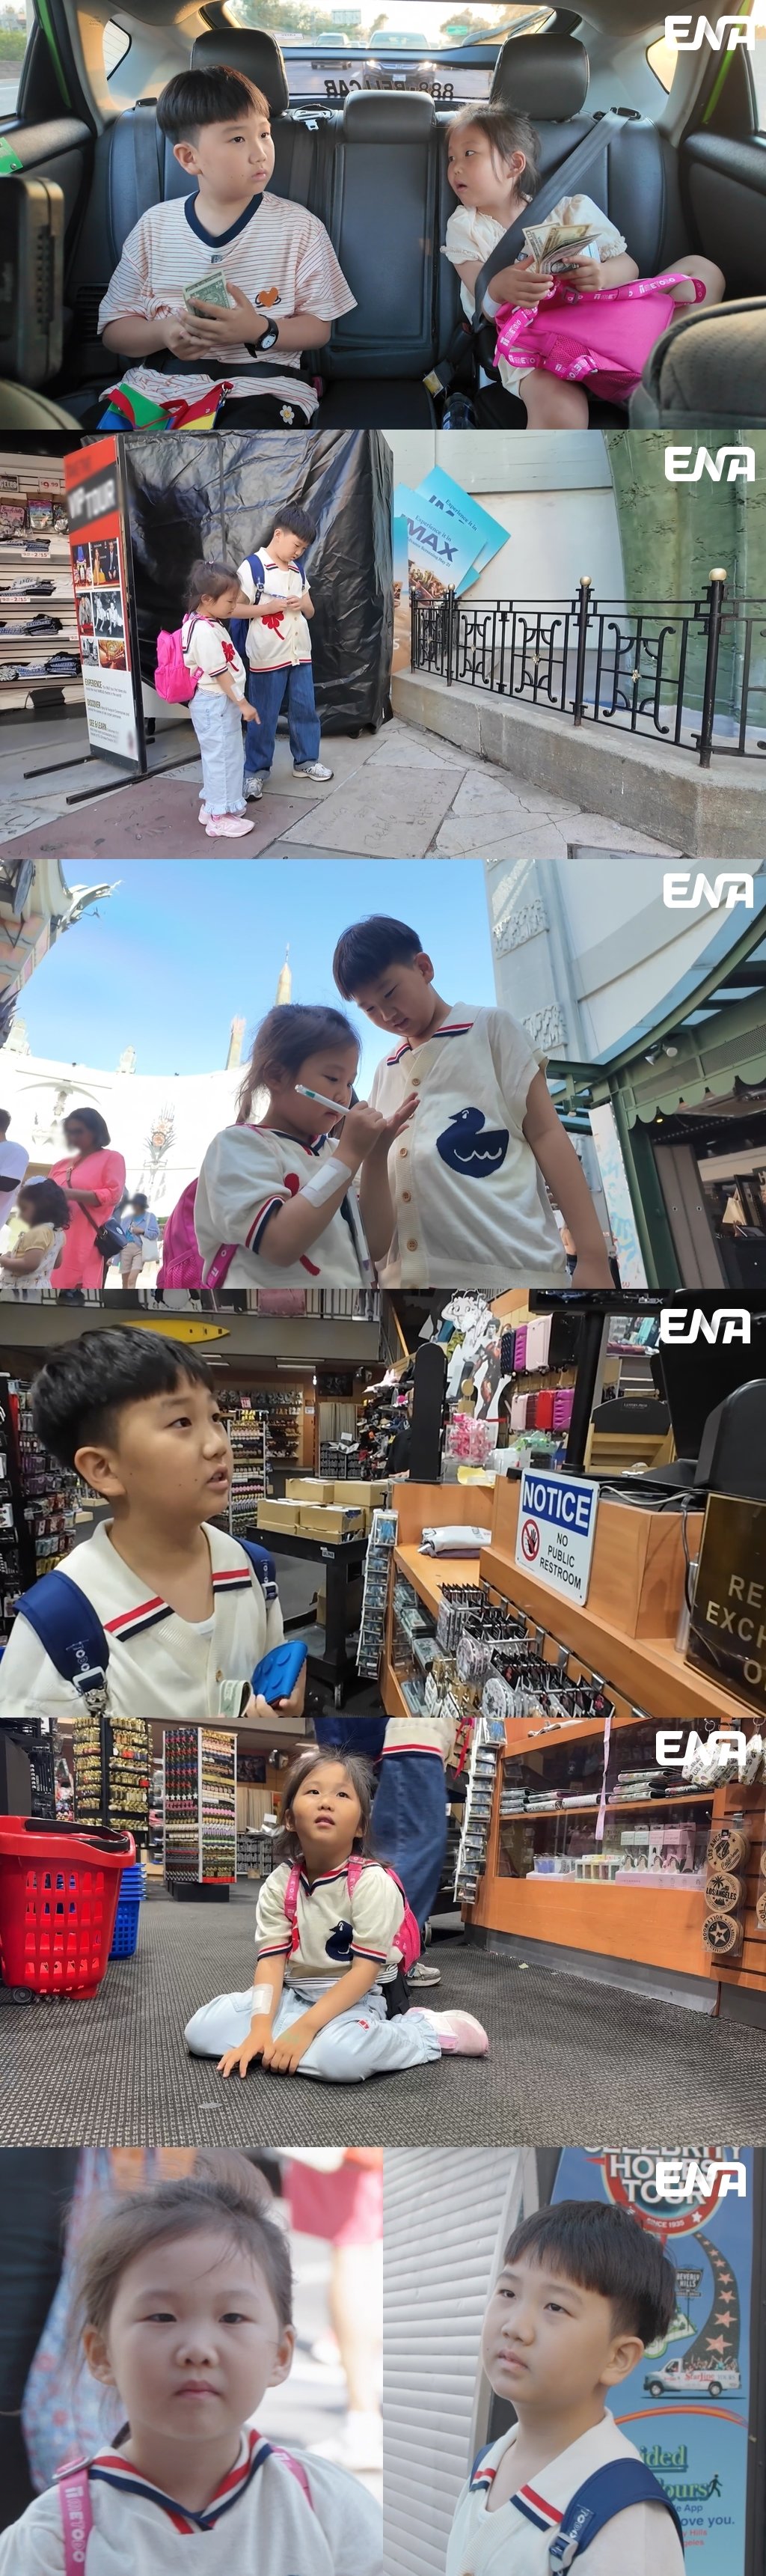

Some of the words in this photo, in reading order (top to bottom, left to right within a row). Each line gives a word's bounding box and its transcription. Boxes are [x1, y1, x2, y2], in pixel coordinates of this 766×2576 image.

[445, 499, 468, 522] Experience
[415, 515, 441, 534] Experience
[401, 513, 459, 562] MAX
[407, 537, 420, 548] dvance
[85, 678, 102, 689] EXPERIENCE
[87, 698, 101, 709] DISCOVER
[523, 1480, 591, 1529] NOTICE
[557, 1532, 569, 1547] NO
[548, 1545, 575, 1568] PUBLIC
[539, 1557, 581, 1590] RESTROOM
[715, 1889, 737, 1900] ANGELES
[702, 1914, 723, 1941] HOLLYWOOD
[676, 2273, 700, 2281] BEVERLY
[679, 2280, 696, 2288] HILLS
[658, 2478, 709, 2500] ours
[684, 2504, 703, 2513] App
[708, 2516, 735, 2528] you.
[690, 2528, 708, 2536] Hills
